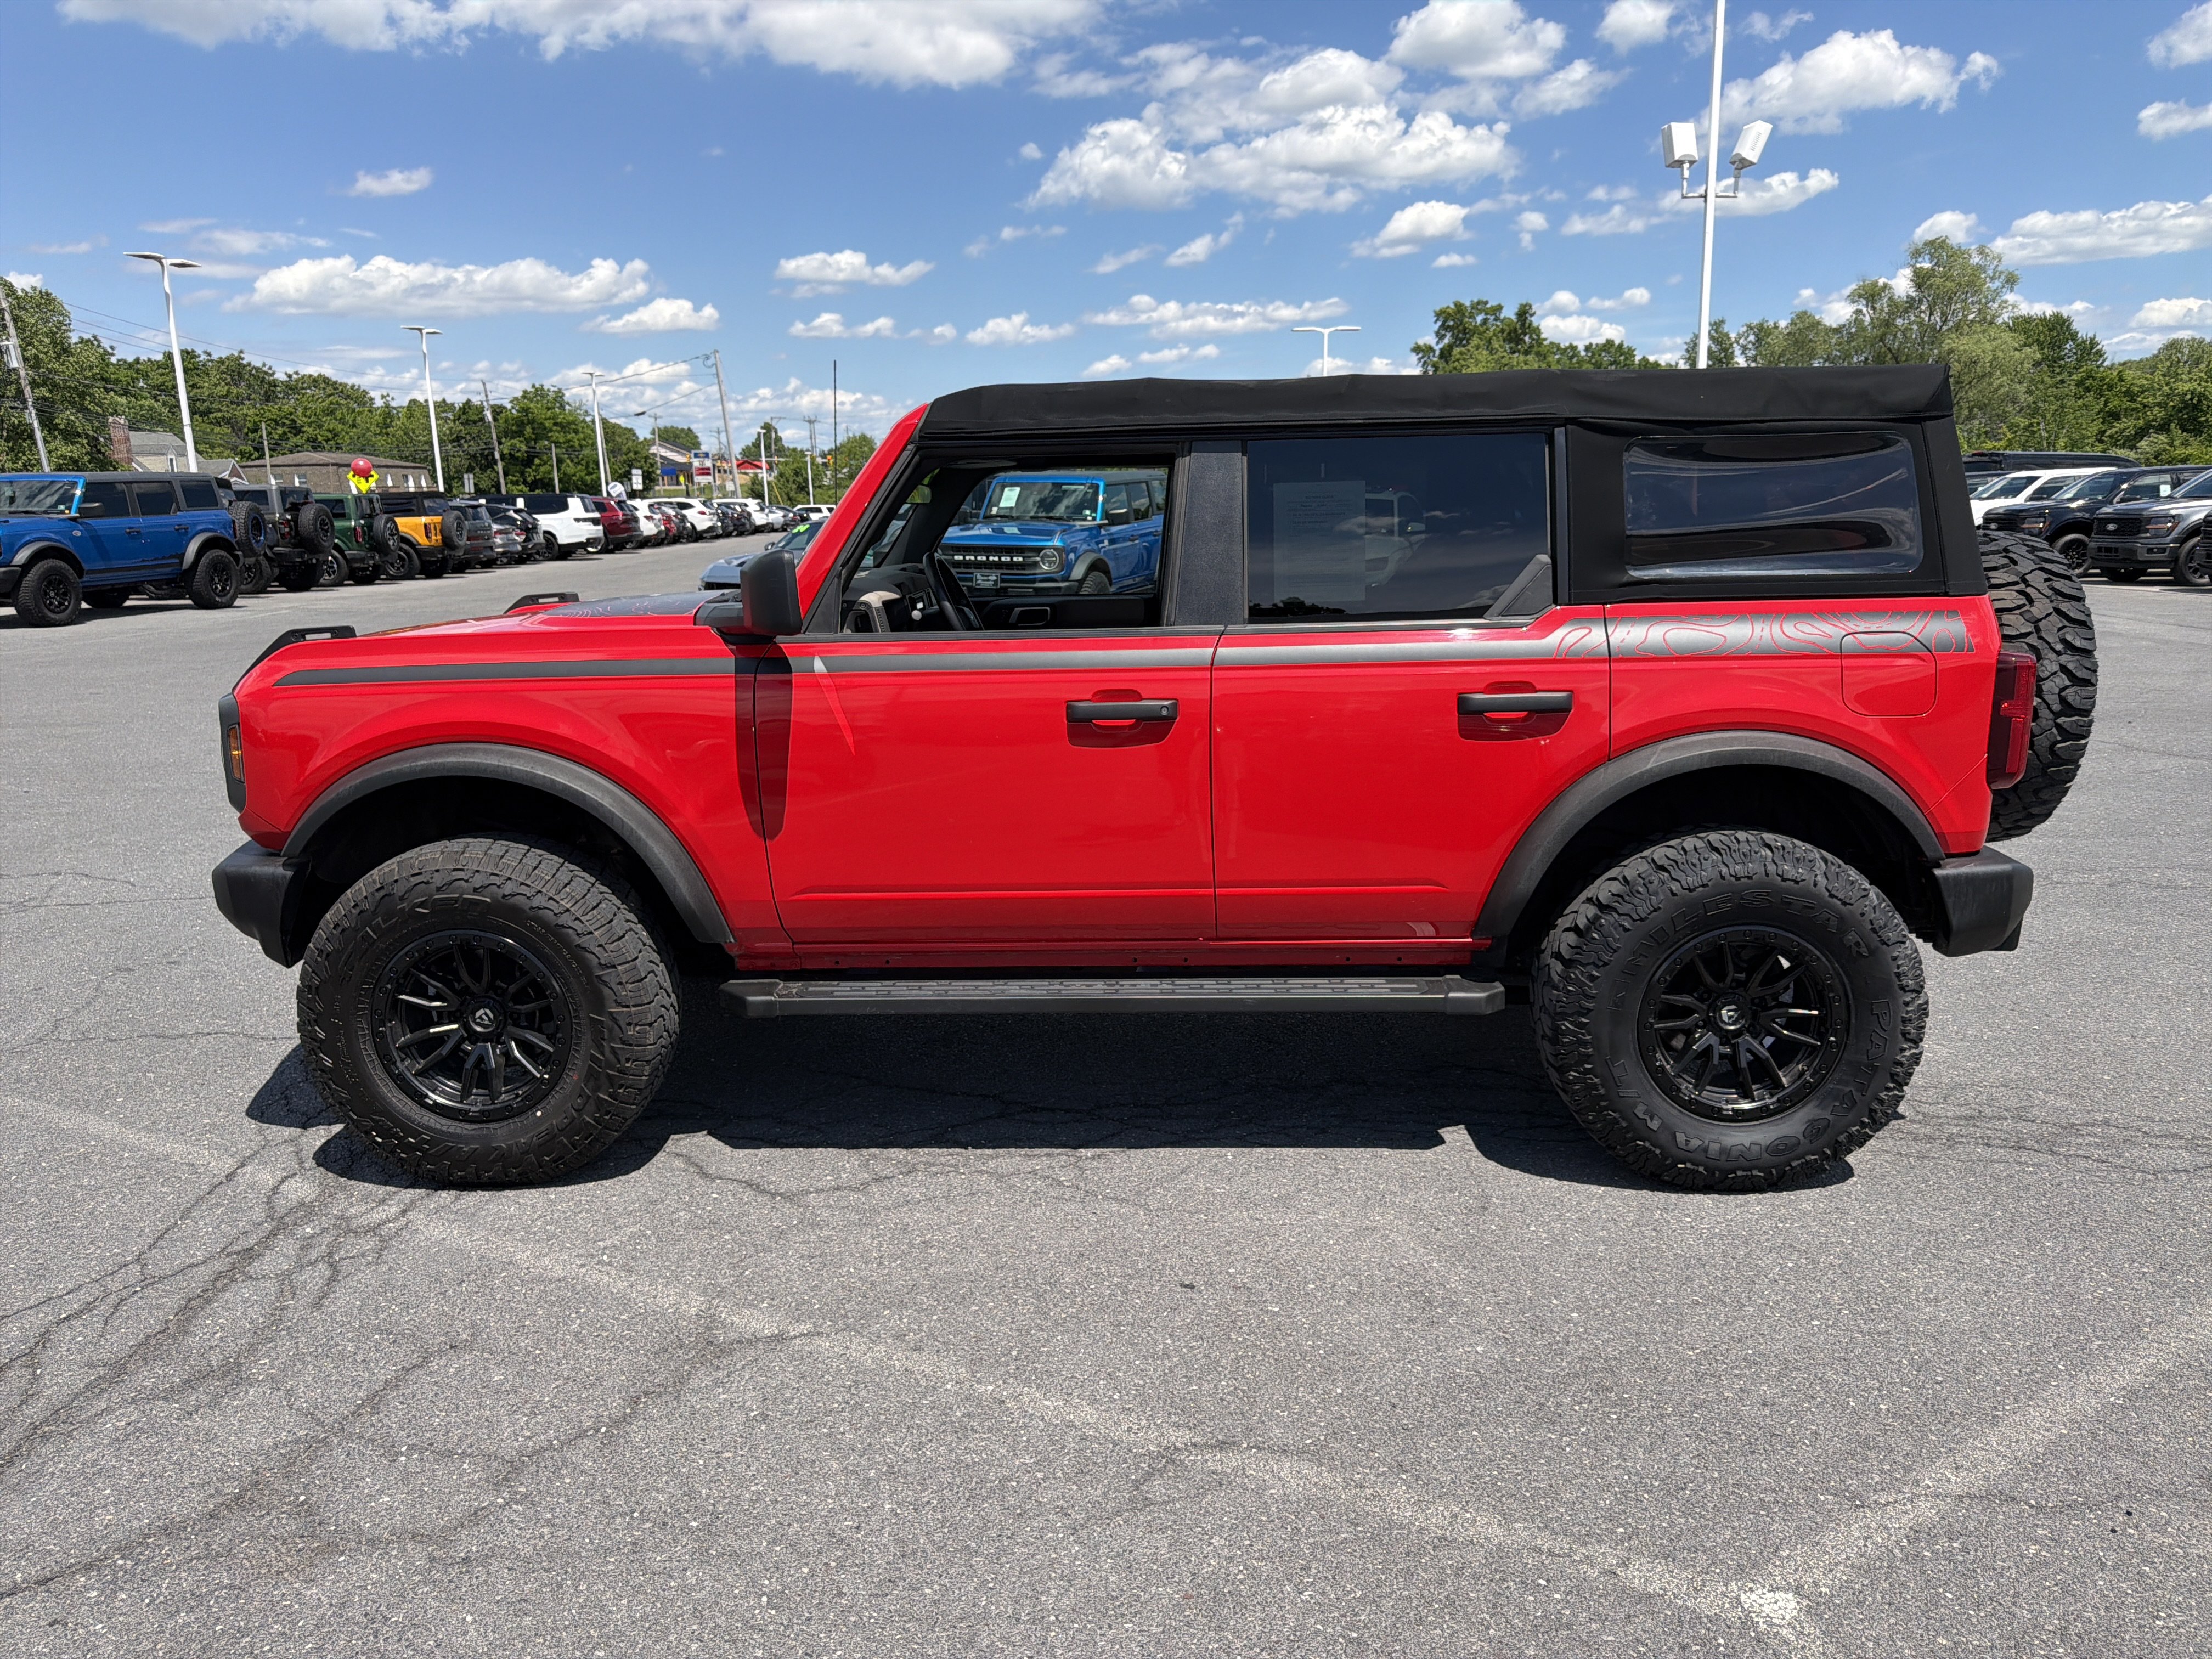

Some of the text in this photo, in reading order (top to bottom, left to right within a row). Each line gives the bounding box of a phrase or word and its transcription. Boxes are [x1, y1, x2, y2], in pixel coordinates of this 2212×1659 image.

[1625, 889, 1869, 972] MILESTAR
[1604, 1000, 1894, 1162] PATAGONIA M/T
